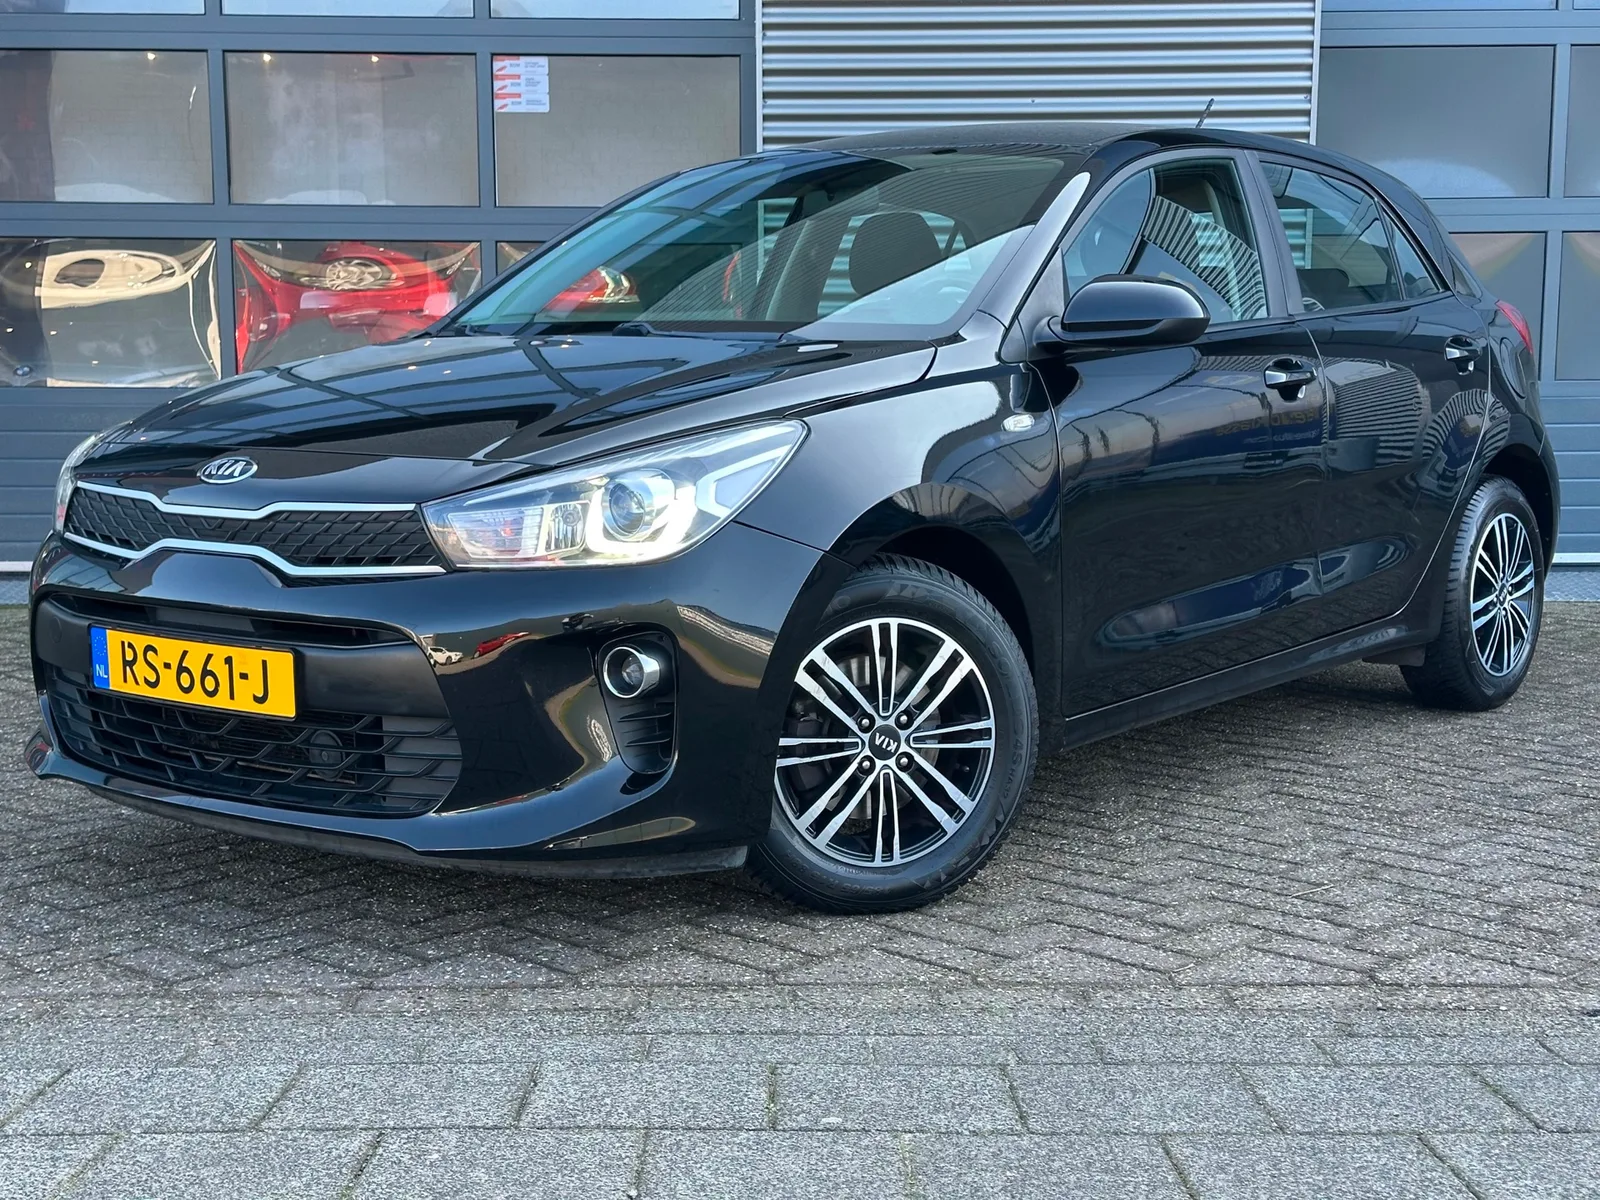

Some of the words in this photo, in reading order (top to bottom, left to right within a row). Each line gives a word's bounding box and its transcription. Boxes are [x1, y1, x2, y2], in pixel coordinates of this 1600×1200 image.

[203, 459, 247, 477] KIA
[96, 664, 108, 678] NL
[121, 640, 269, 705] RS-661-J
[875, 732, 898, 753] KIA
